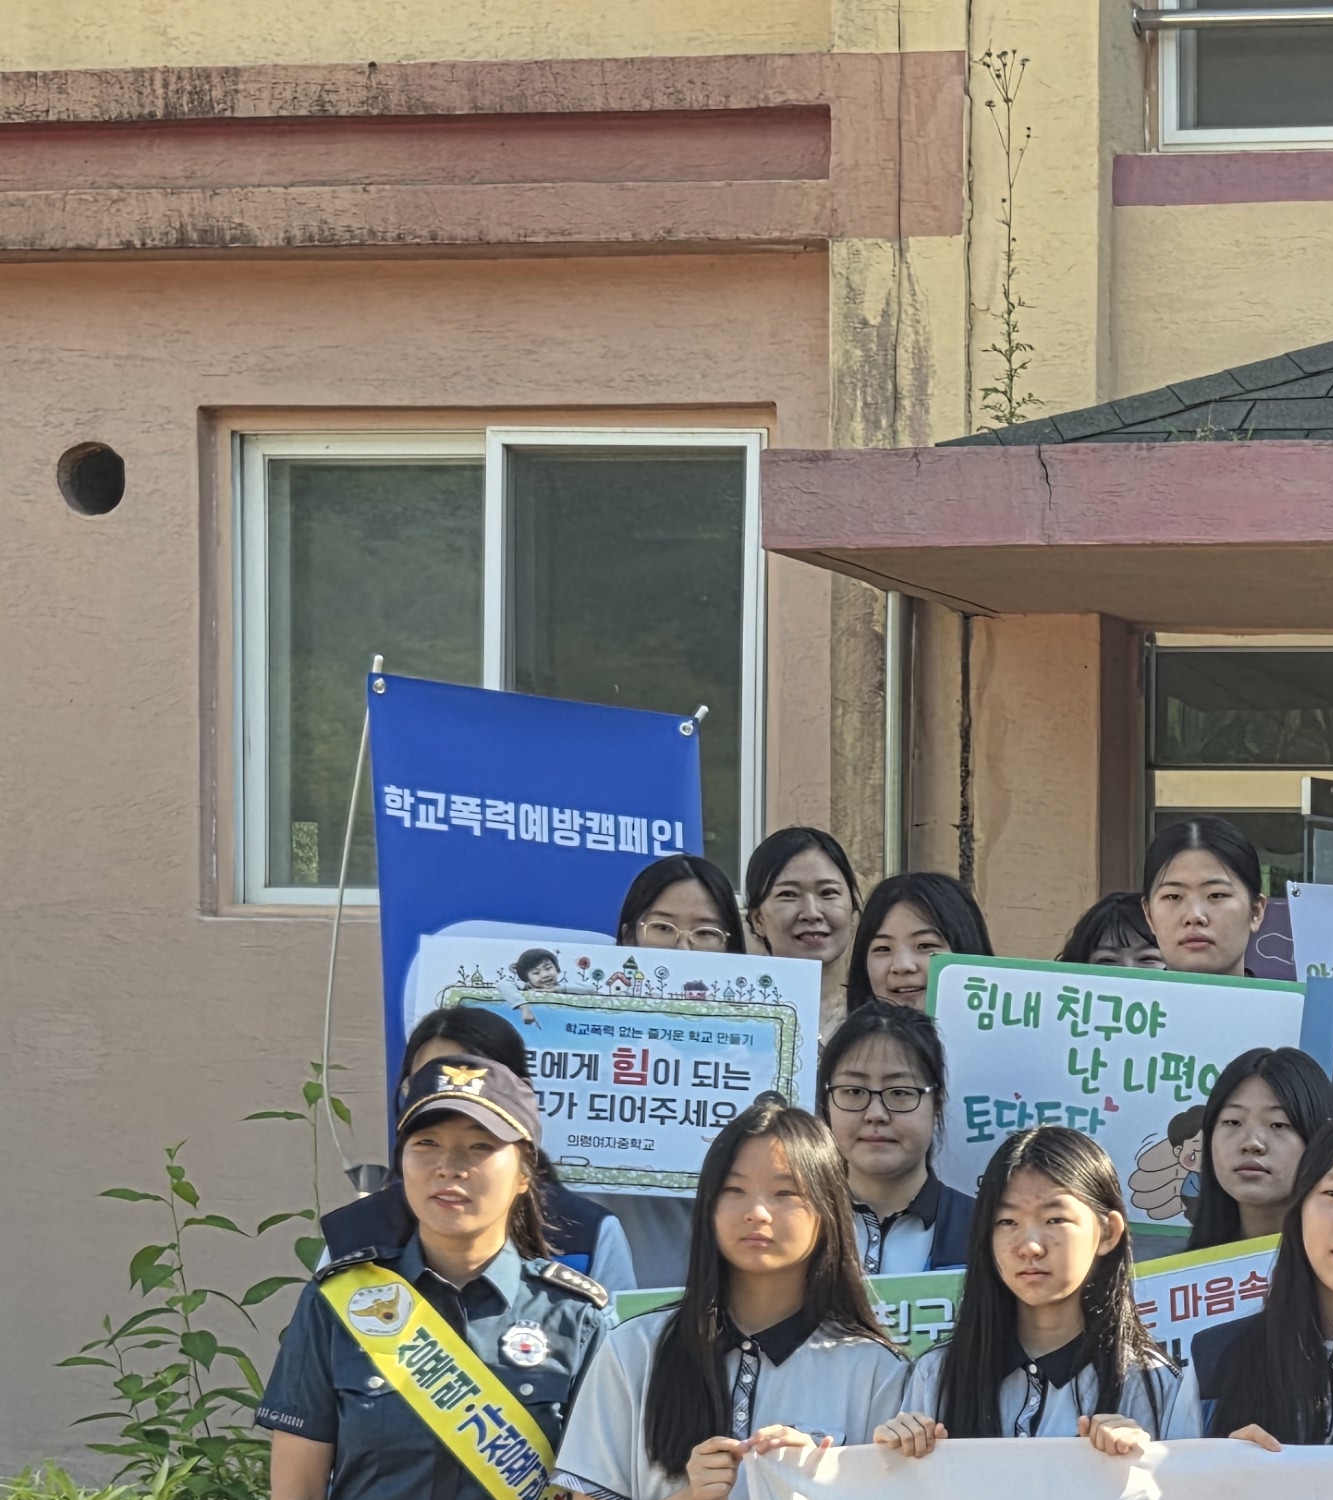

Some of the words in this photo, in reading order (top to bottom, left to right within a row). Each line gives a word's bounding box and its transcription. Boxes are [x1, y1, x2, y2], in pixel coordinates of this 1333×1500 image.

[383, 784, 686, 857] 학교폭력예방캠페인
[963, 976, 1042, 1031] 힘내
[1056, 985, 1168, 1042] 친구야
[565, 1022, 615, 1038] 학교폭력
[619, 1026, 644, 1040] 없는
[648, 1028, 686, 1043] 즐거운
[688, 1030, 713, 1045] 학교
[716, 1032, 754, 1046] 만들기
[612, 1047, 681, 1087] 힘이
[691, 1061, 752, 1091] 되는
[1067, 1047, 1108, 1095] 난
[587, 1091, 740, 1130] 되어주세요
[566, 1134, 656, 1152] 의령여자중학교
